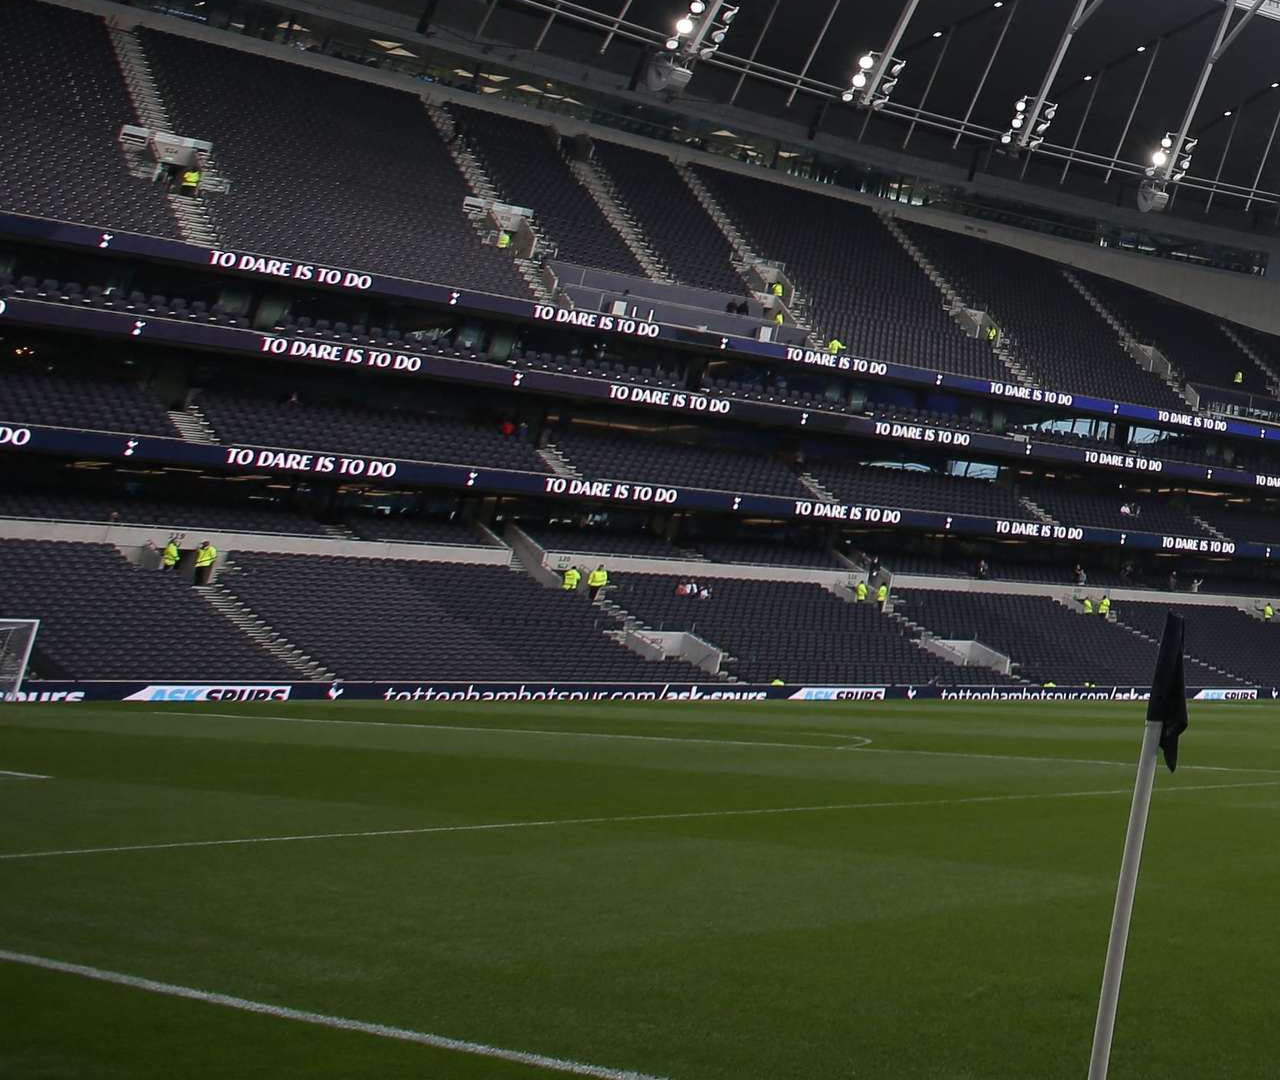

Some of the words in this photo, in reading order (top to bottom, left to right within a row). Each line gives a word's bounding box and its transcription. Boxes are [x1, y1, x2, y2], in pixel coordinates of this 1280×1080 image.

[210, 251, 236, 266] TO
[238, 256, 292, 276] DARE
[294, 265, 313, 279] IS
[317, 269, 341, 284] TO
[343, 273, 371, 289] DO
[534, 305, 554, 319] TO
[555, 309, 597, 327] DARE
[598, 317, 613, 329] IS
[617, 319, 635, 333] TO
[636, 324, 659, 337] DO
[262, 337, 287, 353] TO
[289, 341, 342, 360] DARE
[345, 349, 363, 363] IS
[368, 352, 391, 366] TO
[393, 355, 421, 371] DO
[787, 348, 802, 361] TO
[804, 351, 837, 367] DARE
[838, 357, 850, 369] IS
[853, 359, 867, 371] TO
[869, 362, 887, 375] DO
[610, 385, 628, 399] TO
[630, 388, 670, 405] DARE
[672, 394, 686, 407] IS
[689, 396, 707, 409] TO
[708, 399, 730, 413] DO
[990, 382, 1003, 394] TO
[1004, 385, 1031, 399] DARE
[1032, 390, 1042, 400] IS
[1044, 392, 1056, 403] TO
[1057, 394, 1072, 405] DO
[1158, 411, 1169, 421] TO
[1169, 413, 1192, 425] DARE
[1193, 417, 1201, 427] IS
[1203, 419, 1214, 429] TO
[1214, 420, 1226, 431] DO
[875, 422, 890, 435] TO
[891, 425, 922, 439] DARE
[923, 429, 935, 441] IS
[937, 431, 951, 443] TO
[952, 433, 969, 445] DO
[227, 448, 253, 464] TO
[256, 452, 313, 470] DARE
[315, 457, 335, 472] IS
[340, 459, 364, 474] TO
[366, 462, 396, 477] DO
[1085, 451, 1098, 463] TO
[1098, 453, 1123, 466] DARE
[1124, 457, 1133, 467] IS
[1135, 458, 1147, 469] TO
[1148, 460, 1162, 471] DO
[546, 478, 566, 492] TO
[568, 480, 612, 497] DARE
[614, 485, 629, 498] IS
[633, 486, 652, 500] TO
[654, 489, 677, 503] DO
[1255, 475, 1266, 485] TO
[795, 502, 811, 515] TO
[813, 503, 848, 518] DARE
[849, 507, 862, 519] IS
[865, 508, 880, 521] TO
[882, 510, 900, 523] DO
[996, 521, 1010, 533] TO
[1011, 522, 1039, 536] DARE
[1040, 525, 1051, 537] IS
[1053, 526, 1066, 538] TO
[1067, 528, 1083, 539] DO
[1162, 537, 1174, 548] TO
[1174, 538, 1198, 550] DARE
[1199, 541, 1208, 551] IS
[1210, 541, 1221, 552] TO
[1221, 543, 1235, 553] DO
[151, 688, 203, 701] ASK
[205, 688, 287, 701] SPURS
[836, 689, 883, 700] SPURS
